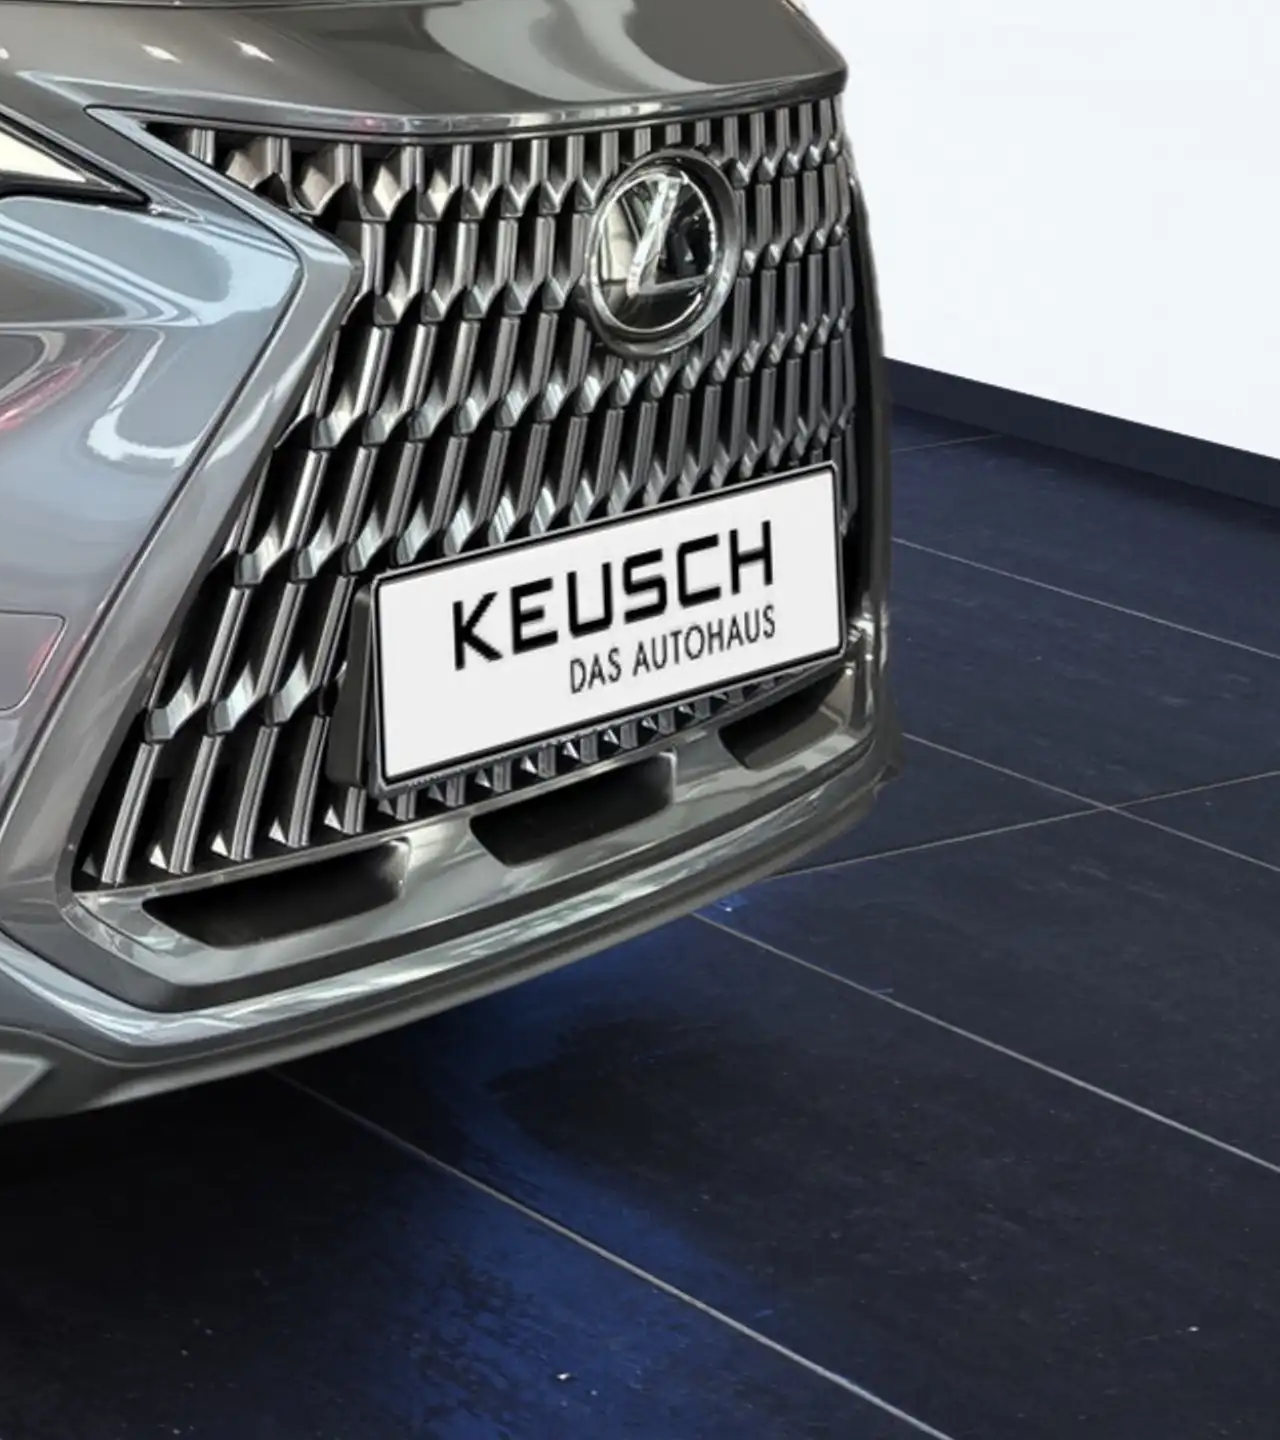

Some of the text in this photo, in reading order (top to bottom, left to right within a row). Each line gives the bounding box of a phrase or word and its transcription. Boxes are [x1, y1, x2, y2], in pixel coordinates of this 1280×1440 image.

[452, 520, 774, 671] KEUSCH
[569, 605, 777, 694] DAS AUTOHAUS
